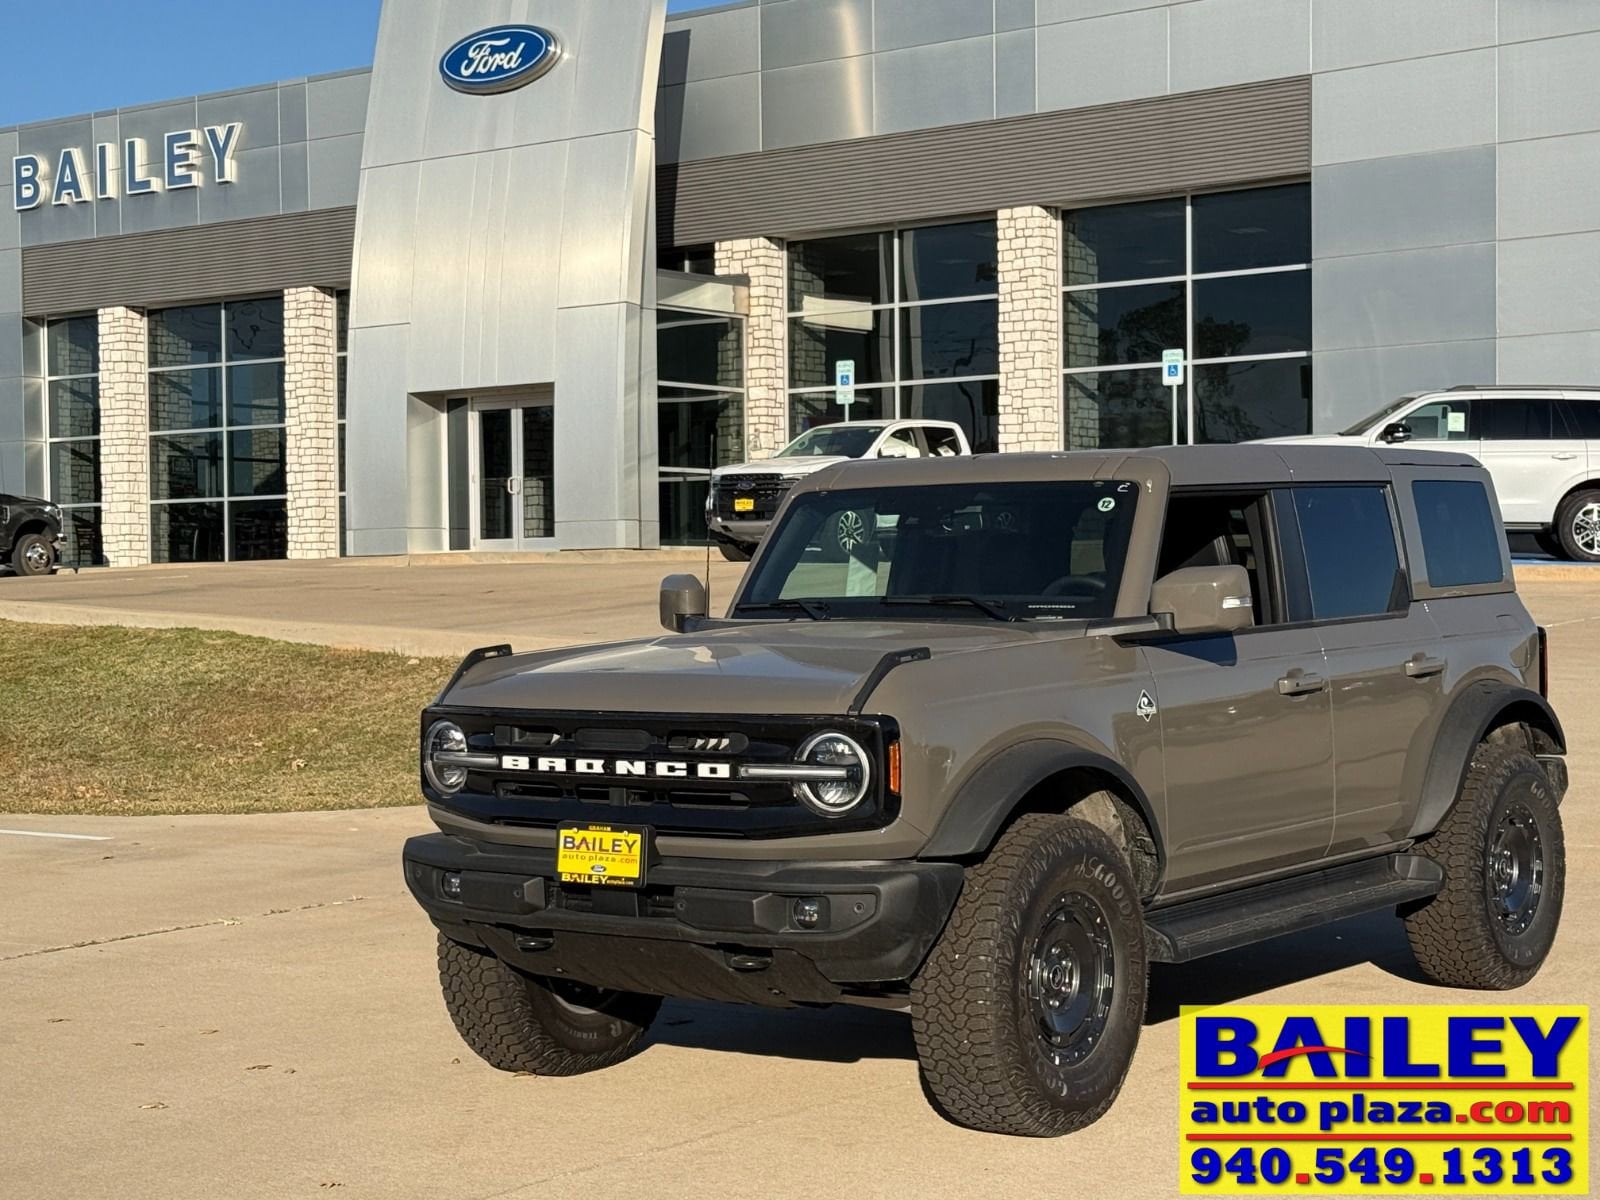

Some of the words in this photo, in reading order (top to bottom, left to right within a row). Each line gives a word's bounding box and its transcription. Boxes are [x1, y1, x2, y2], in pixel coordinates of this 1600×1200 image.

[461, 37, 526, 77] Ford
[13, 122, 242, 210] BAILEY
[501, 755, 731, 779] BRONCO
[563, 836, 638, 854] BAILEY
[562, 853, 587, 861] auto
[561, 873, 608, 885] BAILEY
